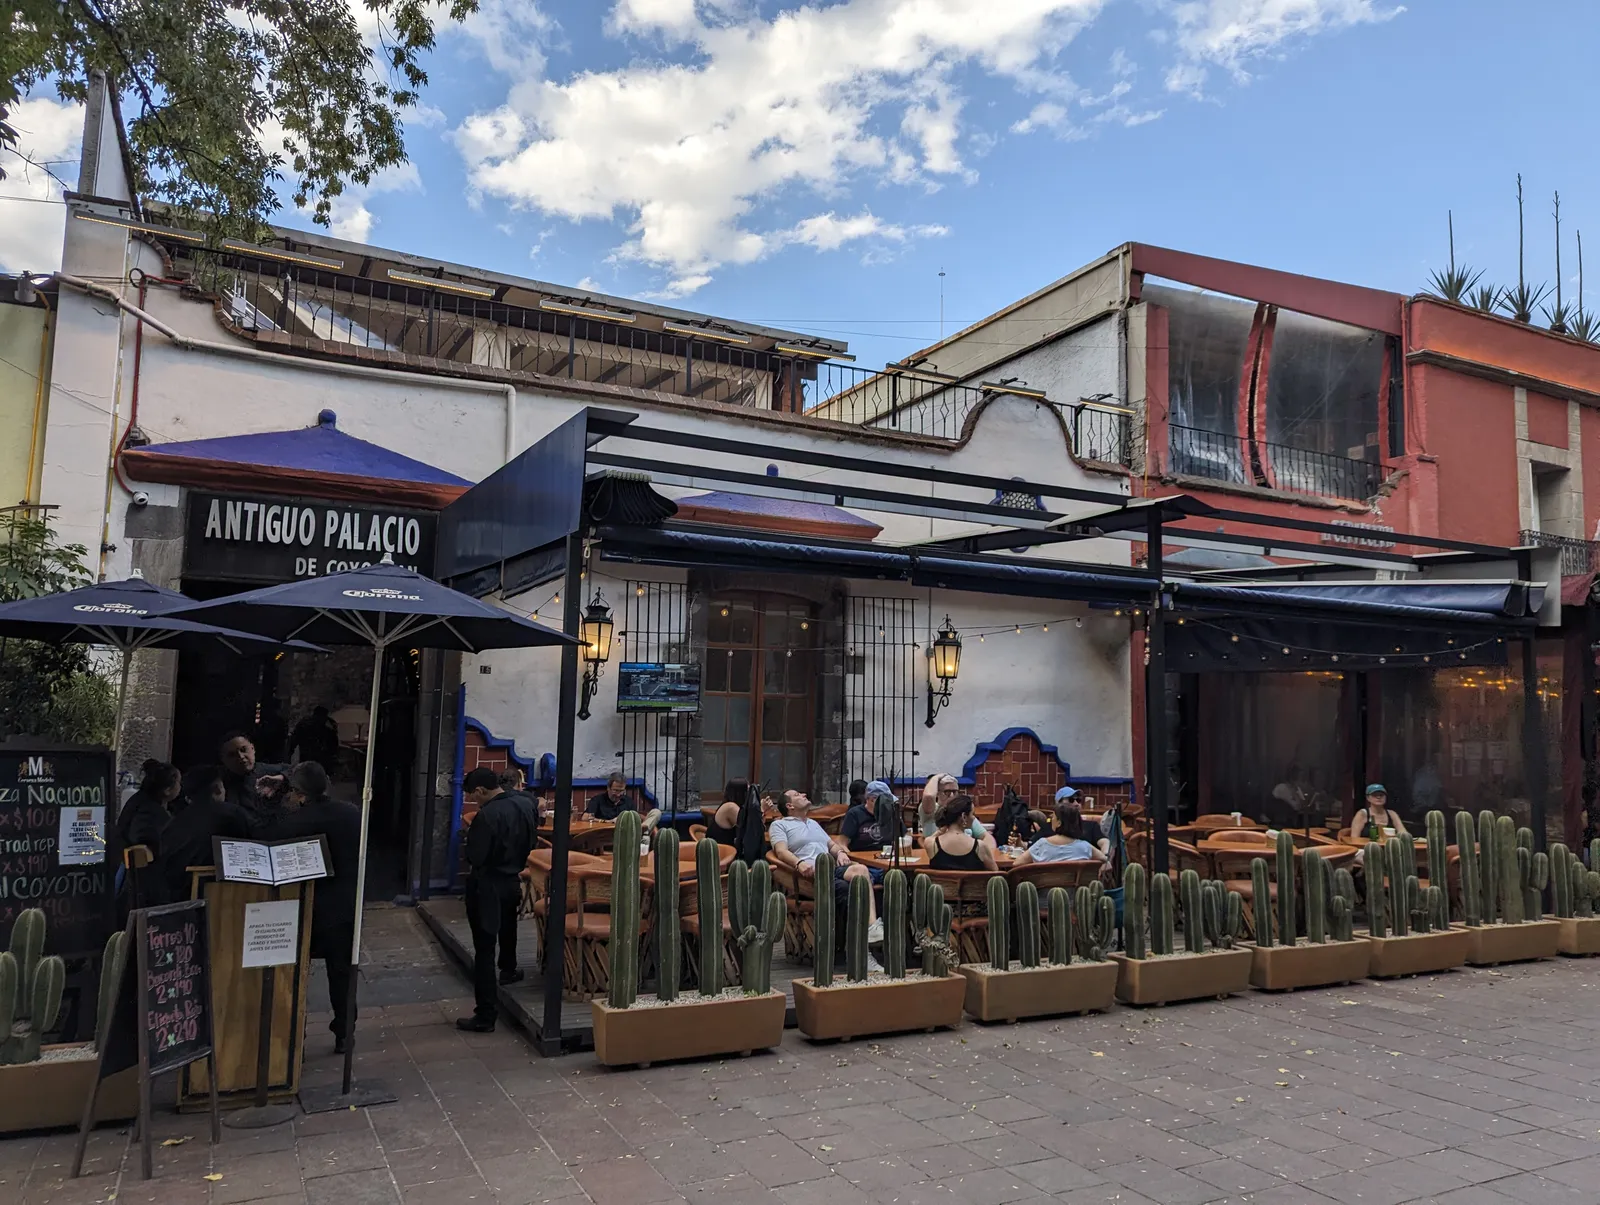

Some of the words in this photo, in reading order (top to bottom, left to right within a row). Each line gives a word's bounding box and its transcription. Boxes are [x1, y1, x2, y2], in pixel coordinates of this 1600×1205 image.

[204, 498, 316, 546] ANTIGUO
[323, 509, 421, 556] PALACIO
[295, 557, 318, 576] DE
[342, 589, 424, 601] Corona
[73, 604, 148, 615] Corona
[28, 756, 43, 776] M
[27, 777, 105, 805] Nacional
[14, 807, 56, 830] $100
[34, 837, 56, 853] rep
[16, 854, 48, 876] $190
[12, 871, 105, 899] COYOTON
[147, 925, 183, 950] Torres
[154, 948, 165, 967] 2
[165, 952, 174, 964] x
[155, 984, 167, 1004] 2
[167, 987, 175, 999] x
[155, 1027, 168, 1053] 2
[167, 1033, 176, 1047] x
